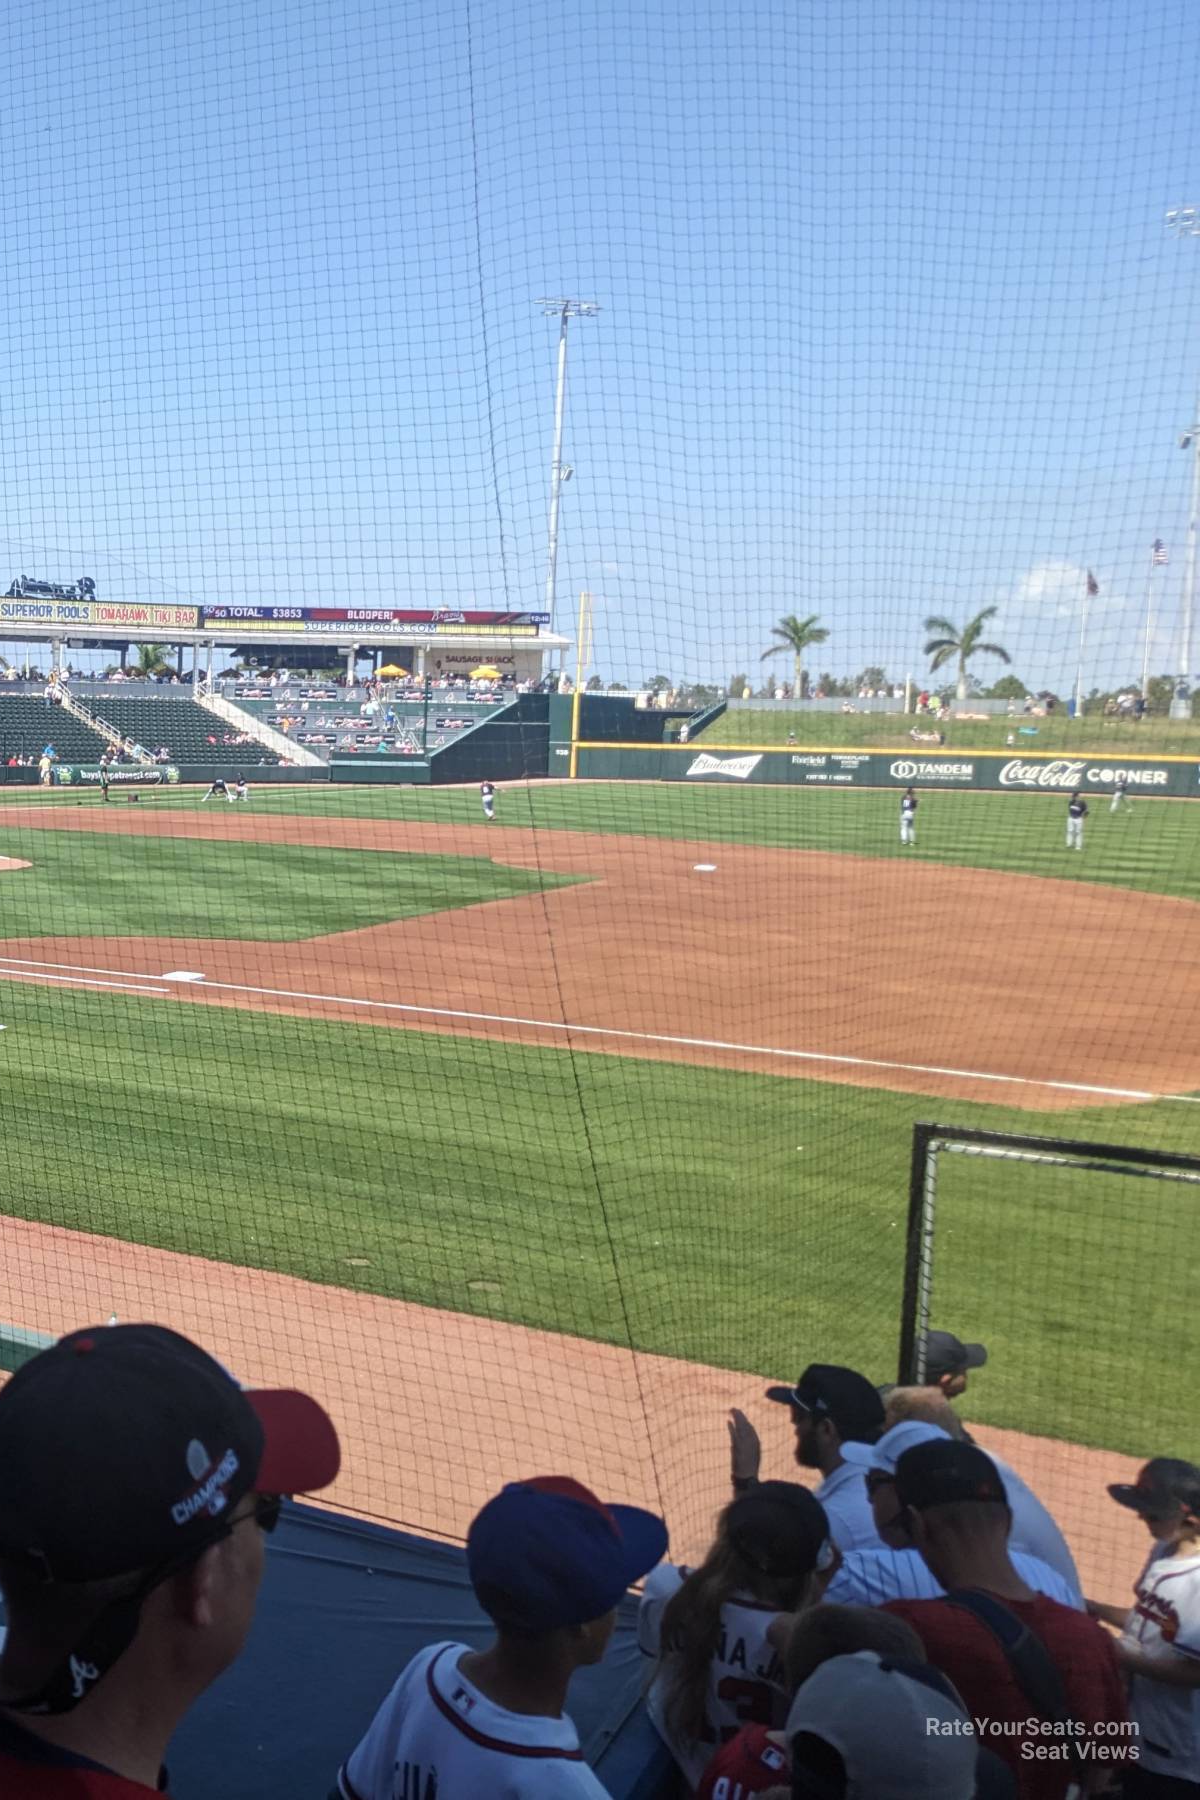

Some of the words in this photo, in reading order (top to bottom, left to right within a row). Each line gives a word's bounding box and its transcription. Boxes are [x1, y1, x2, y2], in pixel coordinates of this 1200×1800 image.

[1, 603, 53, 618] SUPERIOR
[57, 606, 89, 620] POOLS
[95, 607, 149, 622] TOMAHAWK
[153, 609, 171, 623] TIKI
[175, 610, 195, 624] BAR
[228, 607, 263, 617] TOTAL:
[272, 609, 302, 618] $3853
[347, 610, 393, 620] BLOOPER!
[304, 621, 437, 633] SUPERIORPOOLS.COM
[918, 763, 973, 775] TANDEM
[171, 1448, 239, 1525] CHAMPIONS
